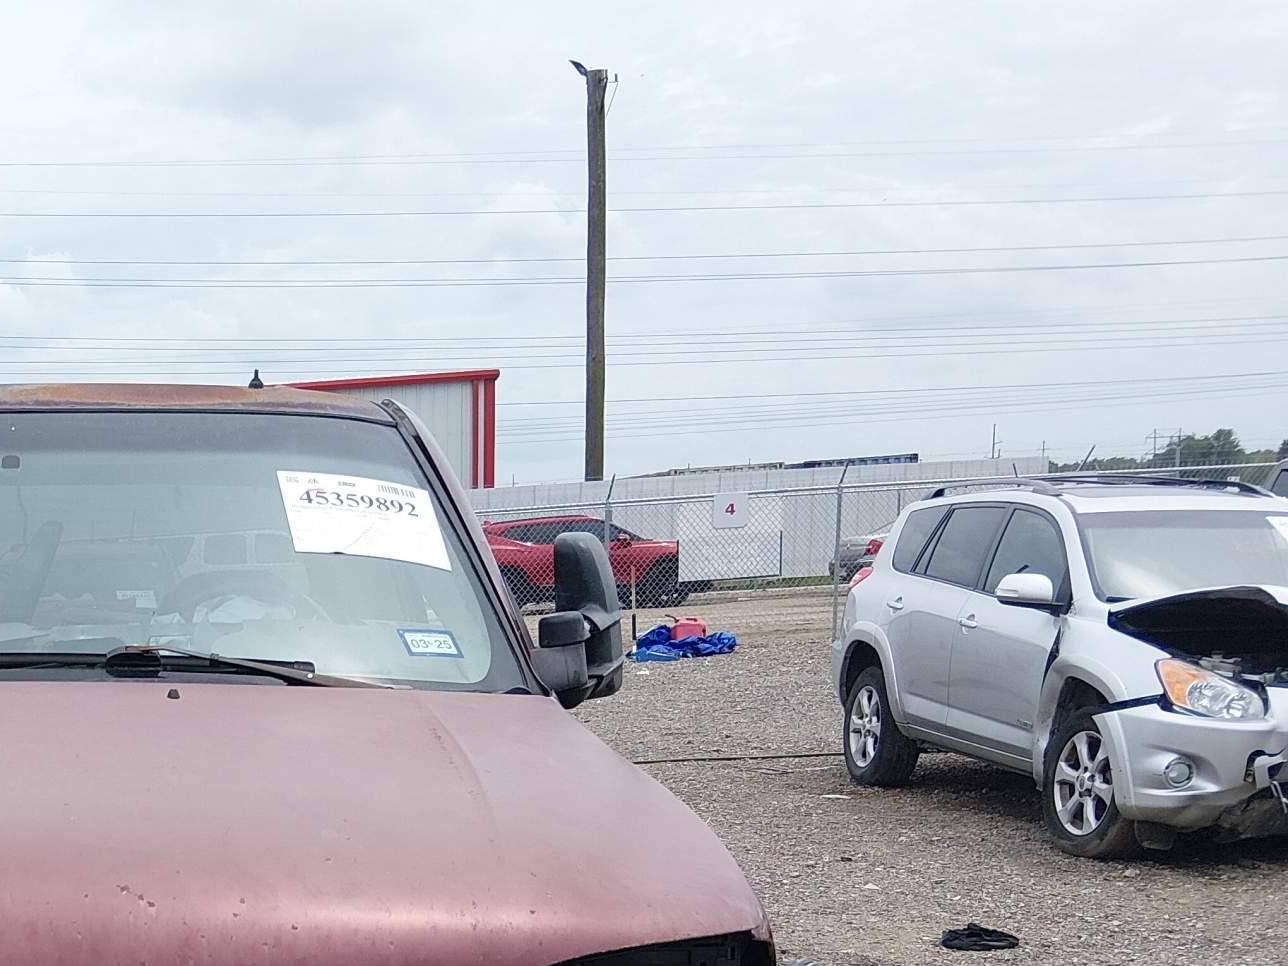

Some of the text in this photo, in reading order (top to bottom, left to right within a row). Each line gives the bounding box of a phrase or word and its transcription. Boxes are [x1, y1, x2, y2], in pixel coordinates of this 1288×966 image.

[299, 488, 419, 518] 45359892
[725, 503, 736, 516] 4
[410, 639, 453, 650] 03 25
